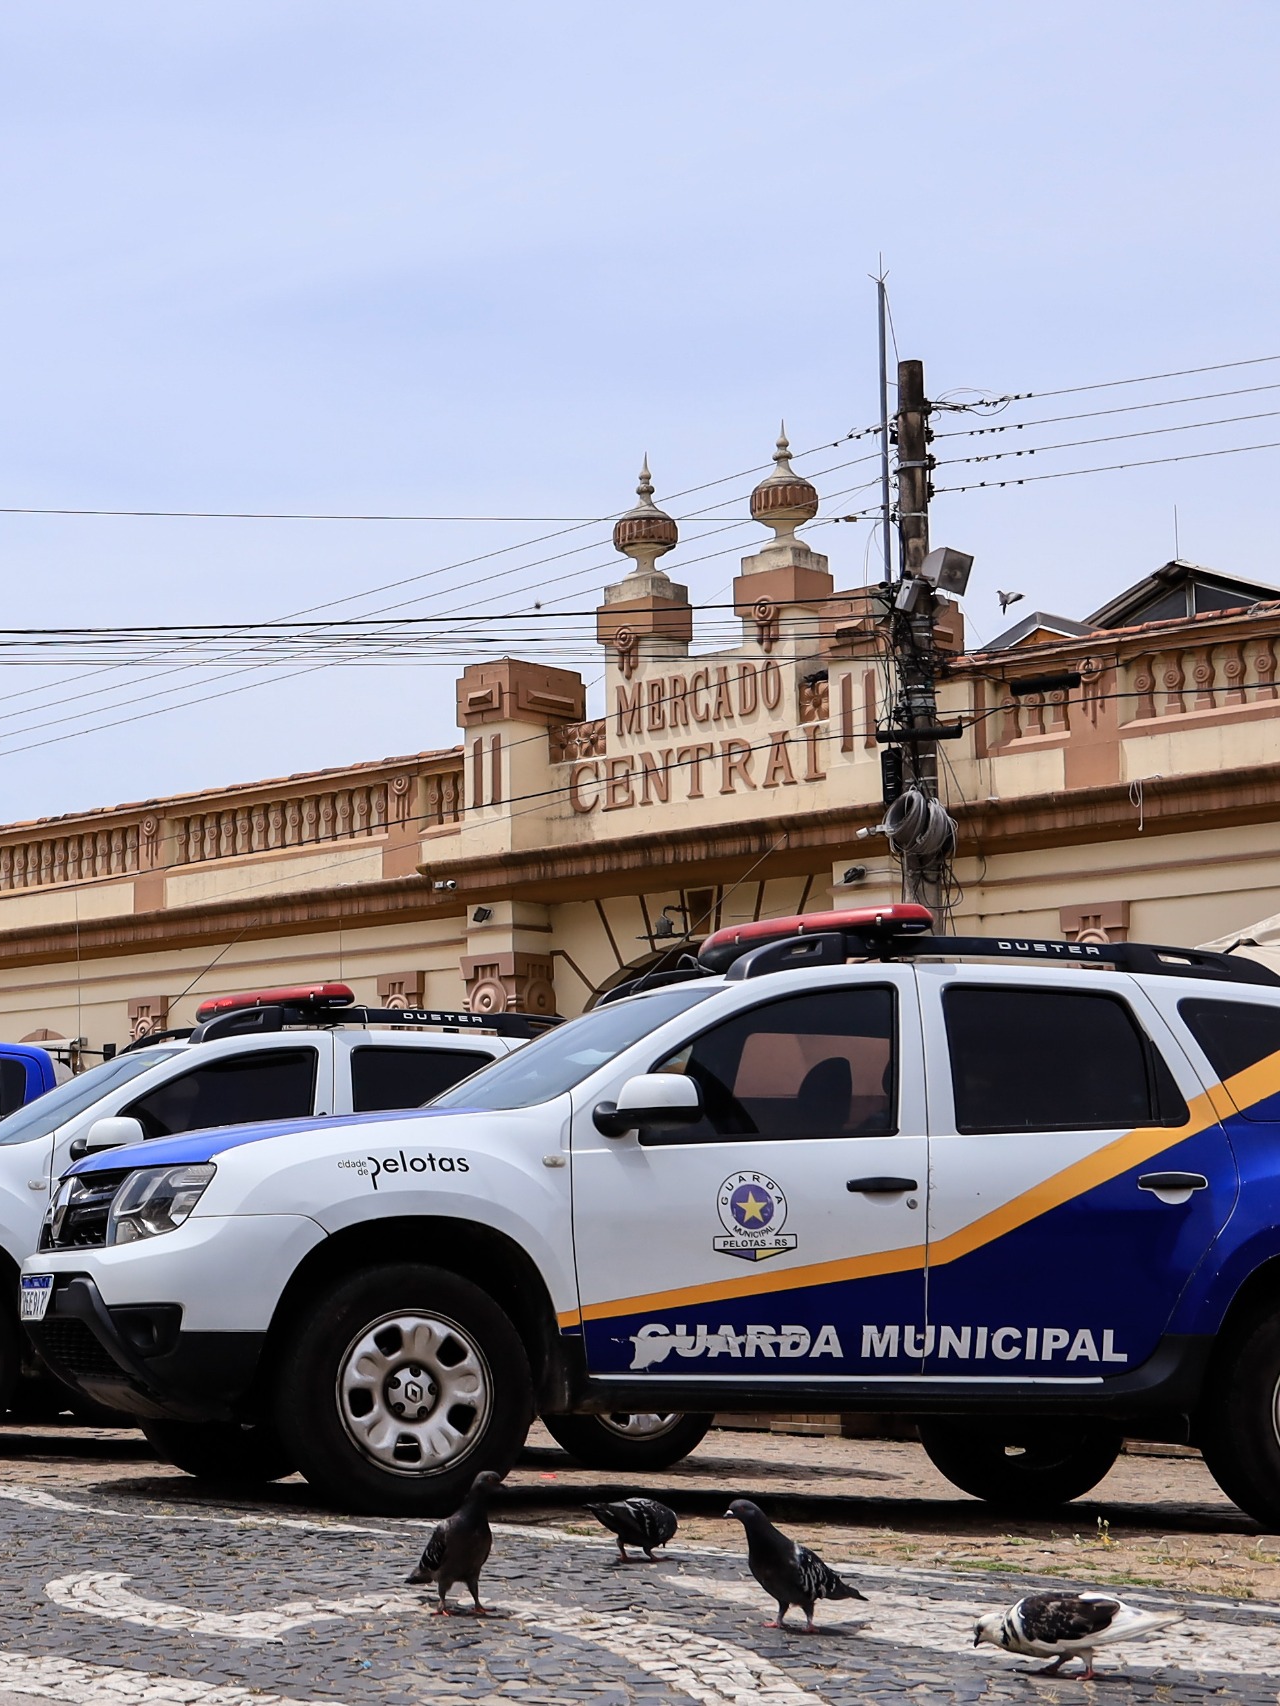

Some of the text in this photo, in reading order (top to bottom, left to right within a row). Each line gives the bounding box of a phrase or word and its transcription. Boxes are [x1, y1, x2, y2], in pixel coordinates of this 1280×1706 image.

[616, 659, 781, 736] MERCADO
[570, 725, 826, 812] CENTRAL
[997, 941, 1100, 955] DUSTER
[403, 1012, 483, 1023] DUSTER
[337, 1159, 367, 1169] cidade
[357, 1167, 369, 1176] de
[721, 1174, 784, 1206] GUARDA
[733, 1225, 776, 1238] MUNICIPAL
[860, 1324, 1128, 1362] MUNICIPAL
